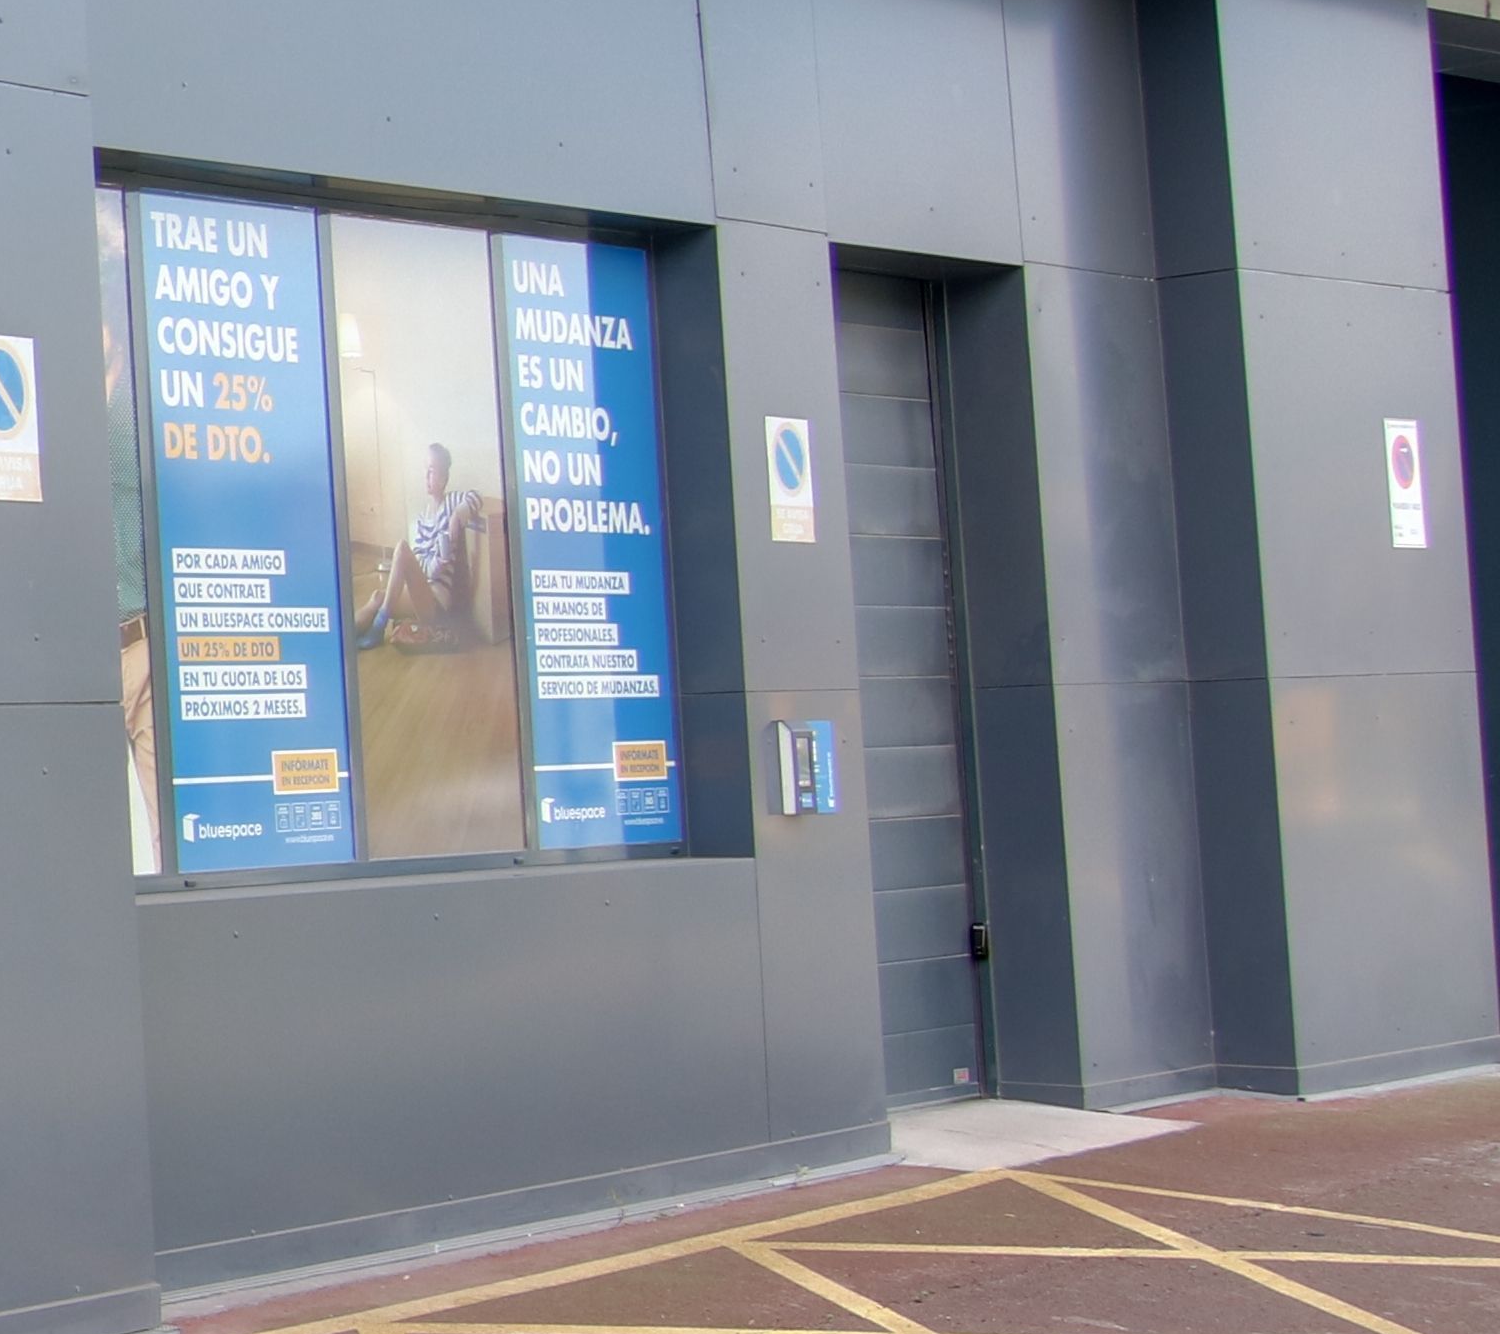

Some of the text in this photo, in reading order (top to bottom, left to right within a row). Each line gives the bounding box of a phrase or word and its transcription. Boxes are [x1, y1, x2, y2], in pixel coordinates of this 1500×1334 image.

[150, 211, 268, 258] TRAE UN
[154, 264, 279, 310] AMIGO Y
[512, 260, 564, 297] UNA
[515, 307, 633, 351] MUDANZA
[157, 316, 299, 363] CONSIGUE
[518, 355, 584, 392] ES UN
[160, 369, 273, 413] UN 25%
[520, 402, 618, 447] CAMBIO,
[163, 422, 271, 464] DE DTO.
[523, 450, 603, 487] NO UN
[526, 497, 650, 536] PROBLEMA.
[176, 553, 282, 571] POR CADA AMIGO
[178, 583, 266, 599] QUE CONTRATE
[534, 575, 625, 590] DEJA TU MUDANZA
[536, 602, 603, 616] EN MANOS DE
[179, 612, 326, 628] UN BLUESPACE CONSIGUE
[538, 628, 615, 642] PROFESIONALES.
[181, 642, 274, 658] UN 25% DE DTO
[539, 654, 635, 668] CONTRATA NUESTRO
[183, 671, 303, 687] EN TU CUOTA DE LOS
[541, 680, 657, 695] SERVICIO DE MUDANZAS.
[185, 697, 303, 717] PRÓXIMOS 2 MESES.
[554, 806, 605, 822] bluespace
[198, 822, 263, 841] bluespace
